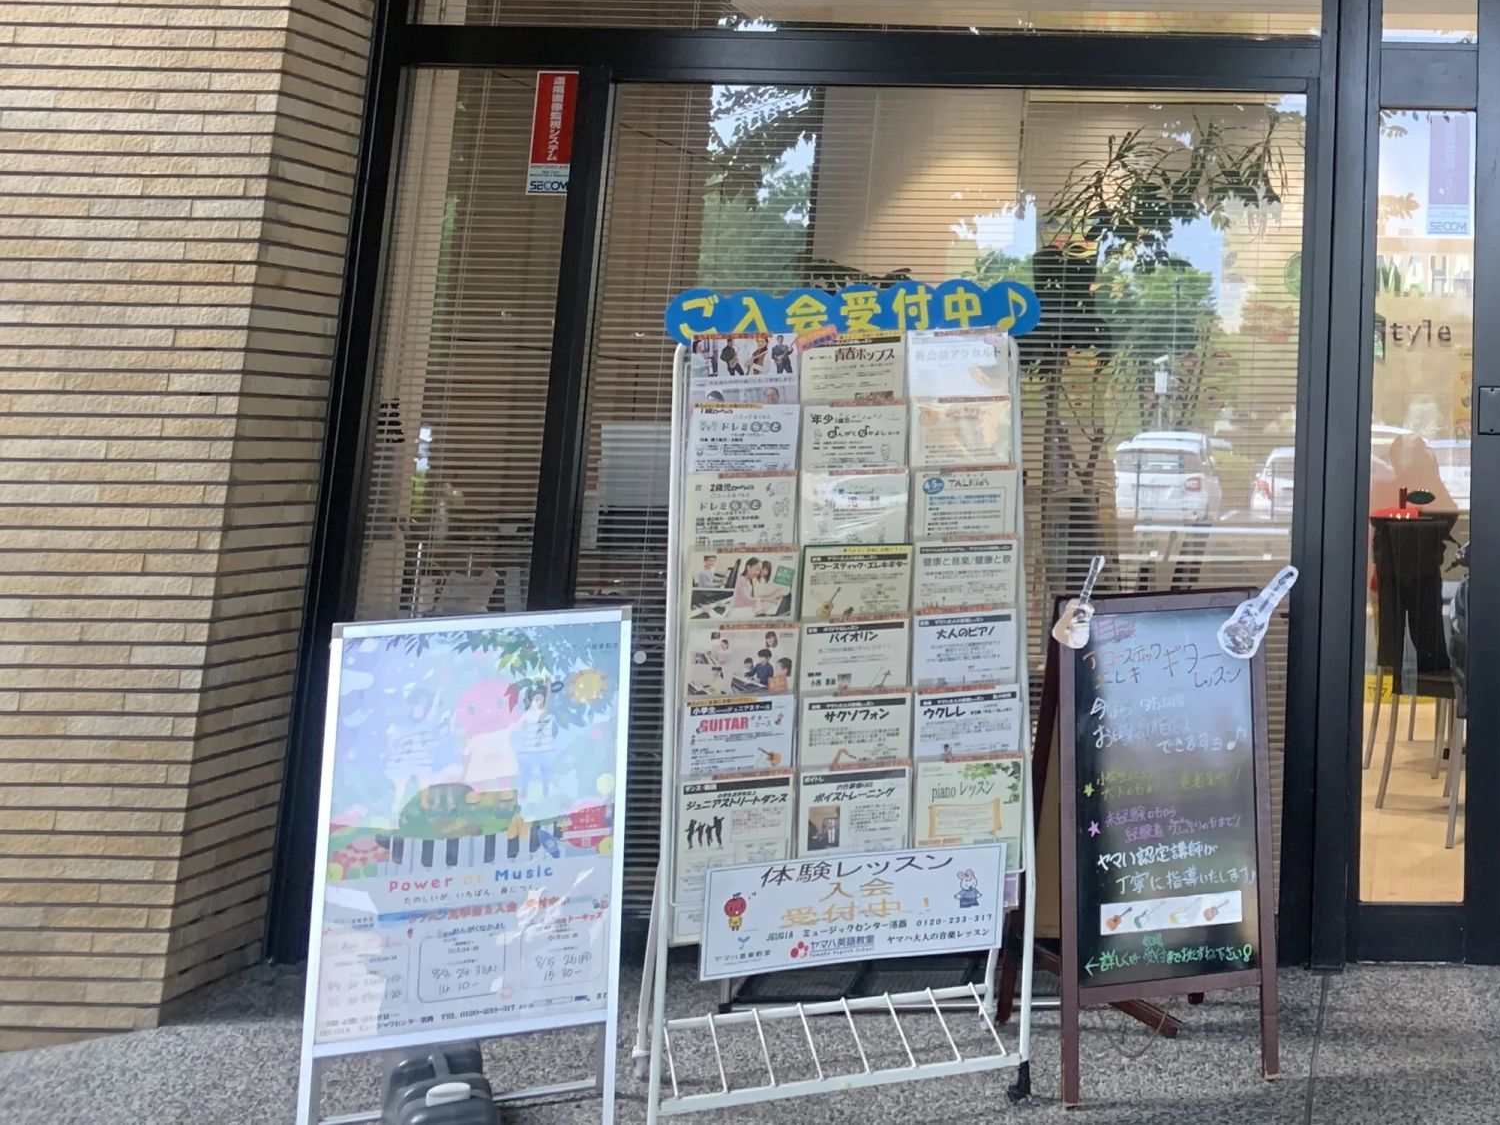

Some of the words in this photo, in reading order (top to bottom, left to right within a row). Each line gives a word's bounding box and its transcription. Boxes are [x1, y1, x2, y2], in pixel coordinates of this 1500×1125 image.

[829, 631, 878, 643] バイオリン
[936, 626, 995, 640] 大人のピアノ
[824, 708, 889, 723] サクソフォン
[923, 705, 966, 719] ウクレレ
[699, 717, 749, 733] GUITAR
[813, 787, 897, 803] ボイストレーニング
[931, 783, 956, 802] piano
[960, 781, 995, 798] レッスン
[686, 793, 789, 811] ジュニアストリートダンス
[760, 854, 954, 888] 体験レッスン
[389, 877, 453, 893] Power
[495, 867, 553, 881] Music
[818, 877, 895, 903] 入会
[766, 931, 794, 942] JEUGIA
[887, 928, 990, 944] ヤマハ大人の音楽レッスン
